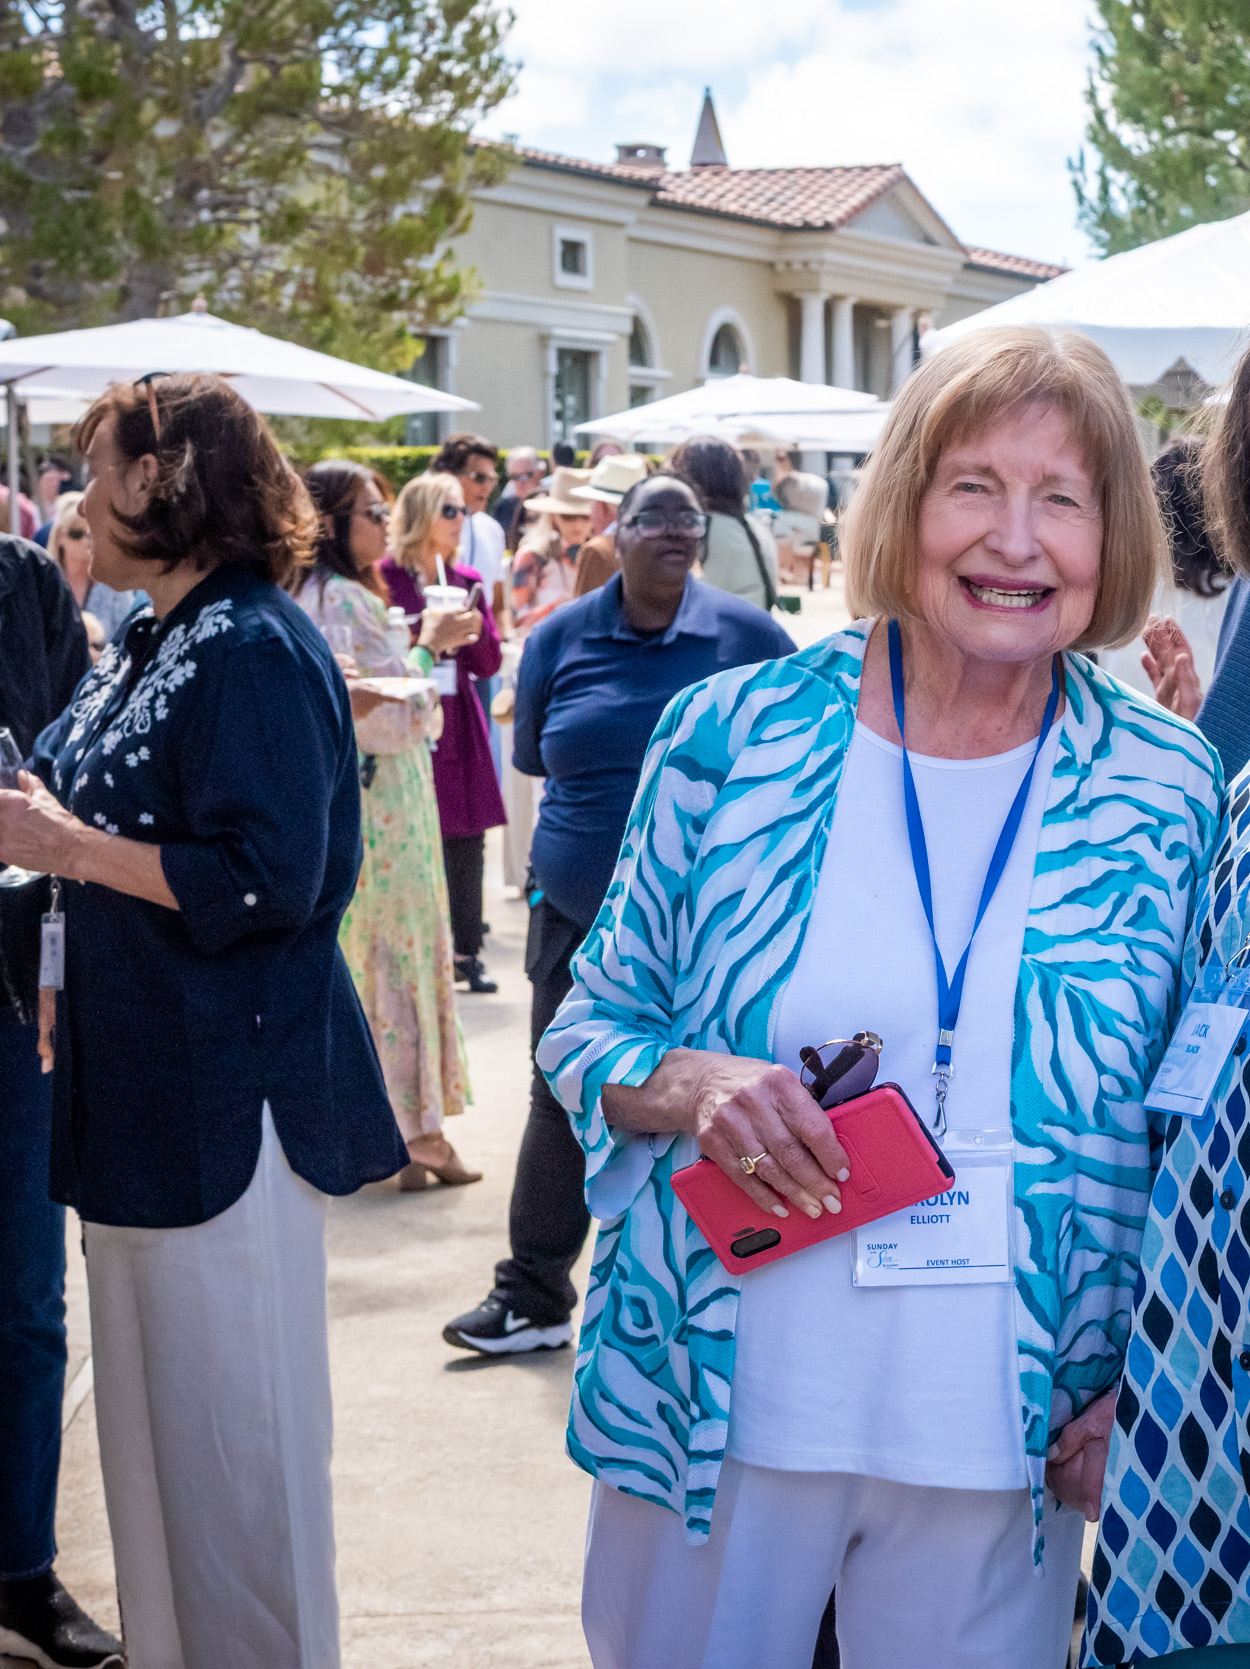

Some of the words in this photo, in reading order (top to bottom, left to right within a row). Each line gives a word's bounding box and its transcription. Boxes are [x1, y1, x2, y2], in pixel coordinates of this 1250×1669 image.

[1191, 1024, 1210, 1038] JACK
[910, 1191, 970, 1207] OLYN
[910, 1214, 951, 1225] ELLIOTT
[866, 1243, 898, 1251] SUNDAY
